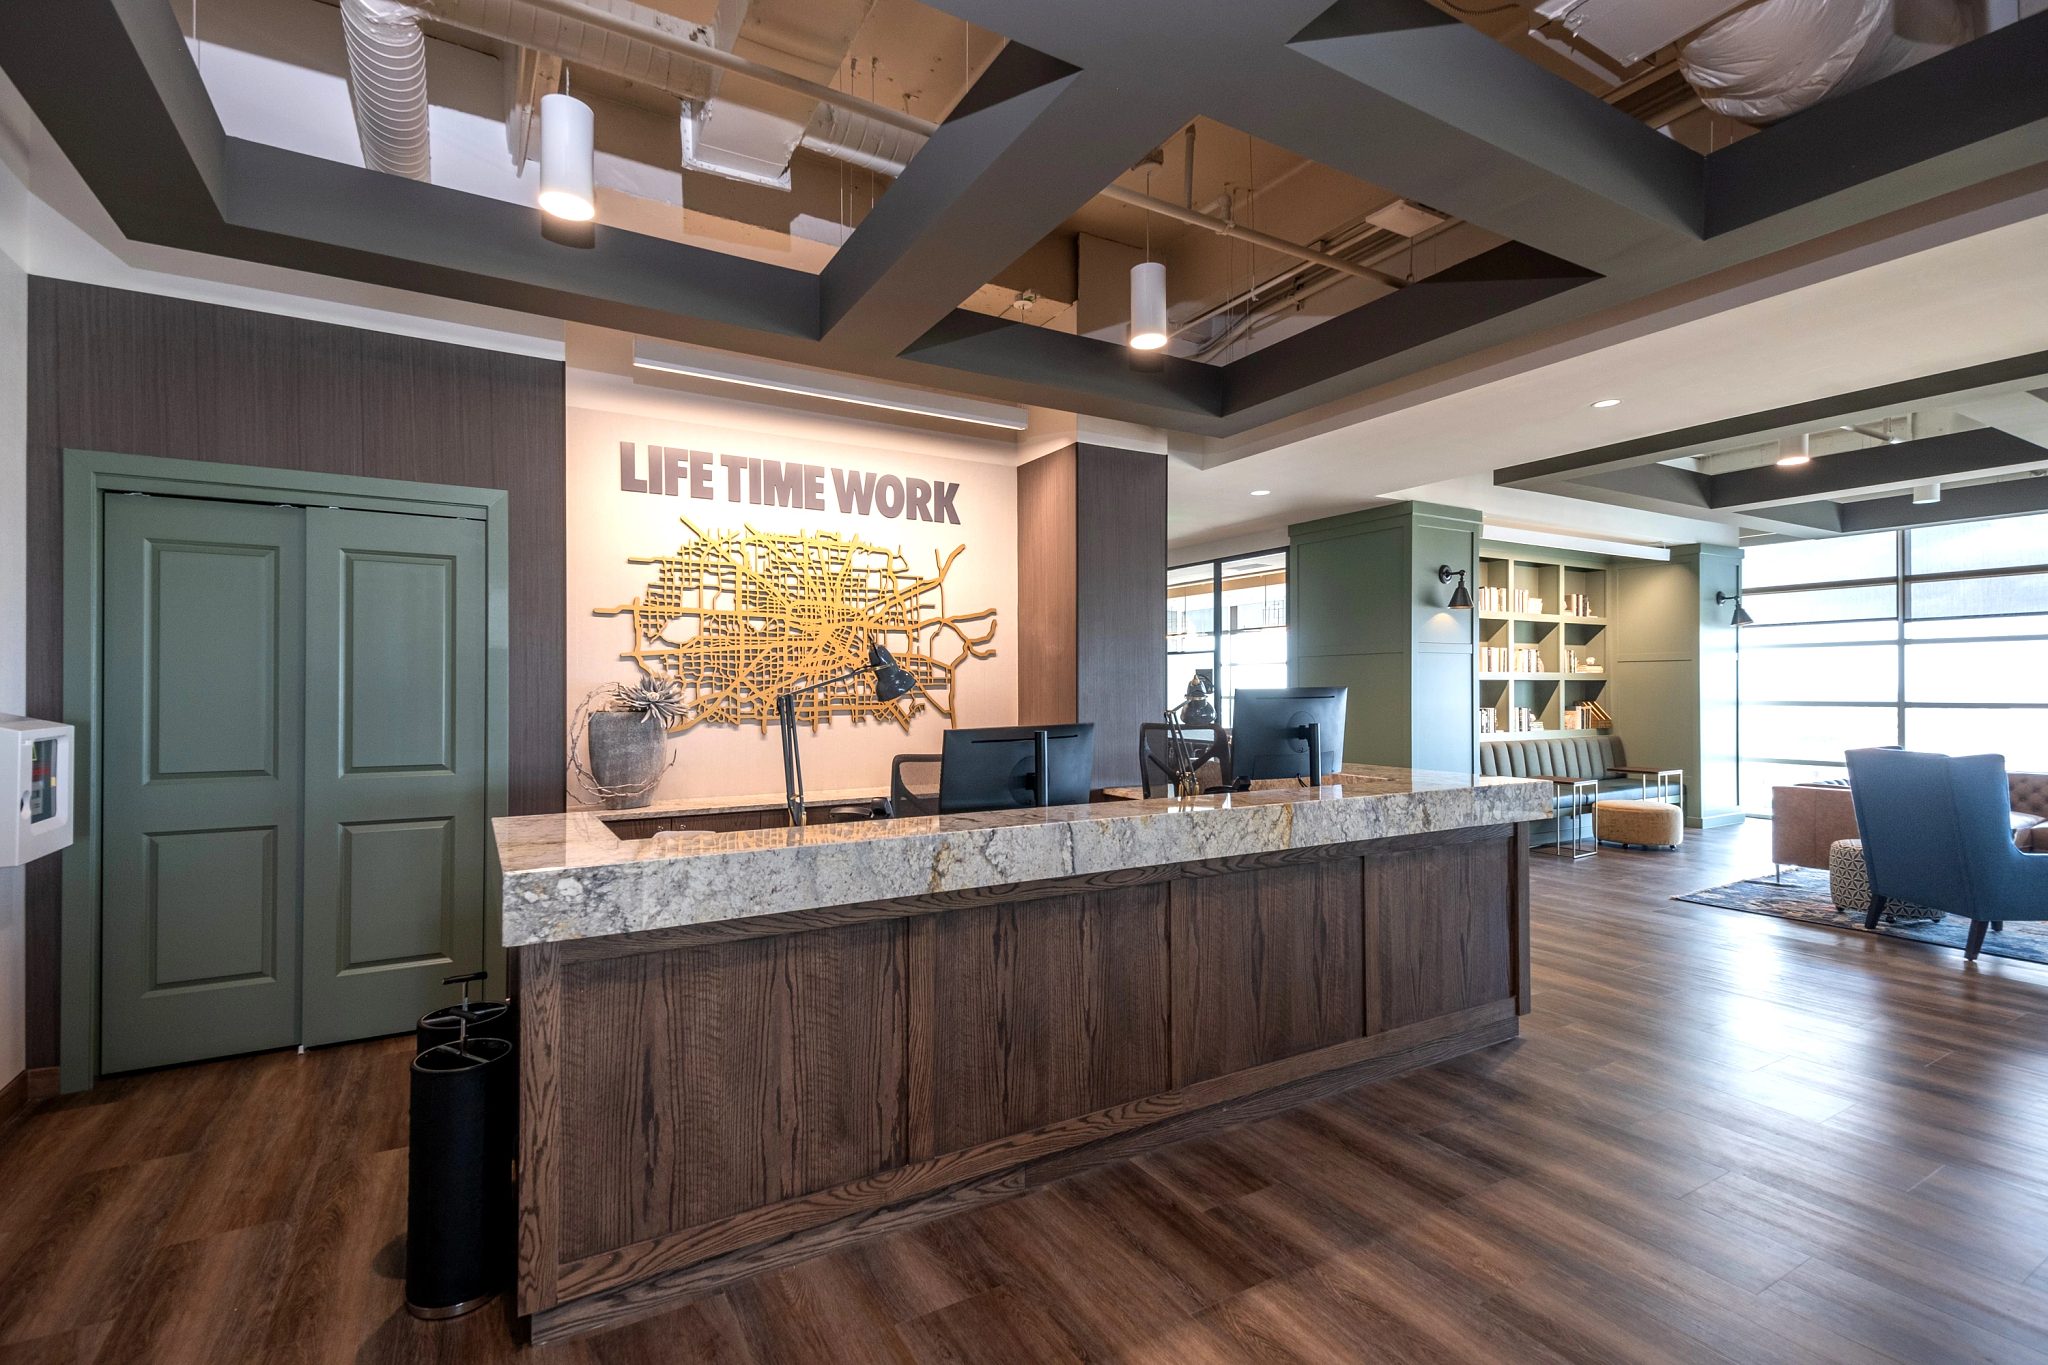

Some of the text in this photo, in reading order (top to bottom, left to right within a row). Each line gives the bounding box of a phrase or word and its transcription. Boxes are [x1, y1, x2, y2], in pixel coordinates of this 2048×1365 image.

[620, 441, 961, 525] LIFE TIME WORK
